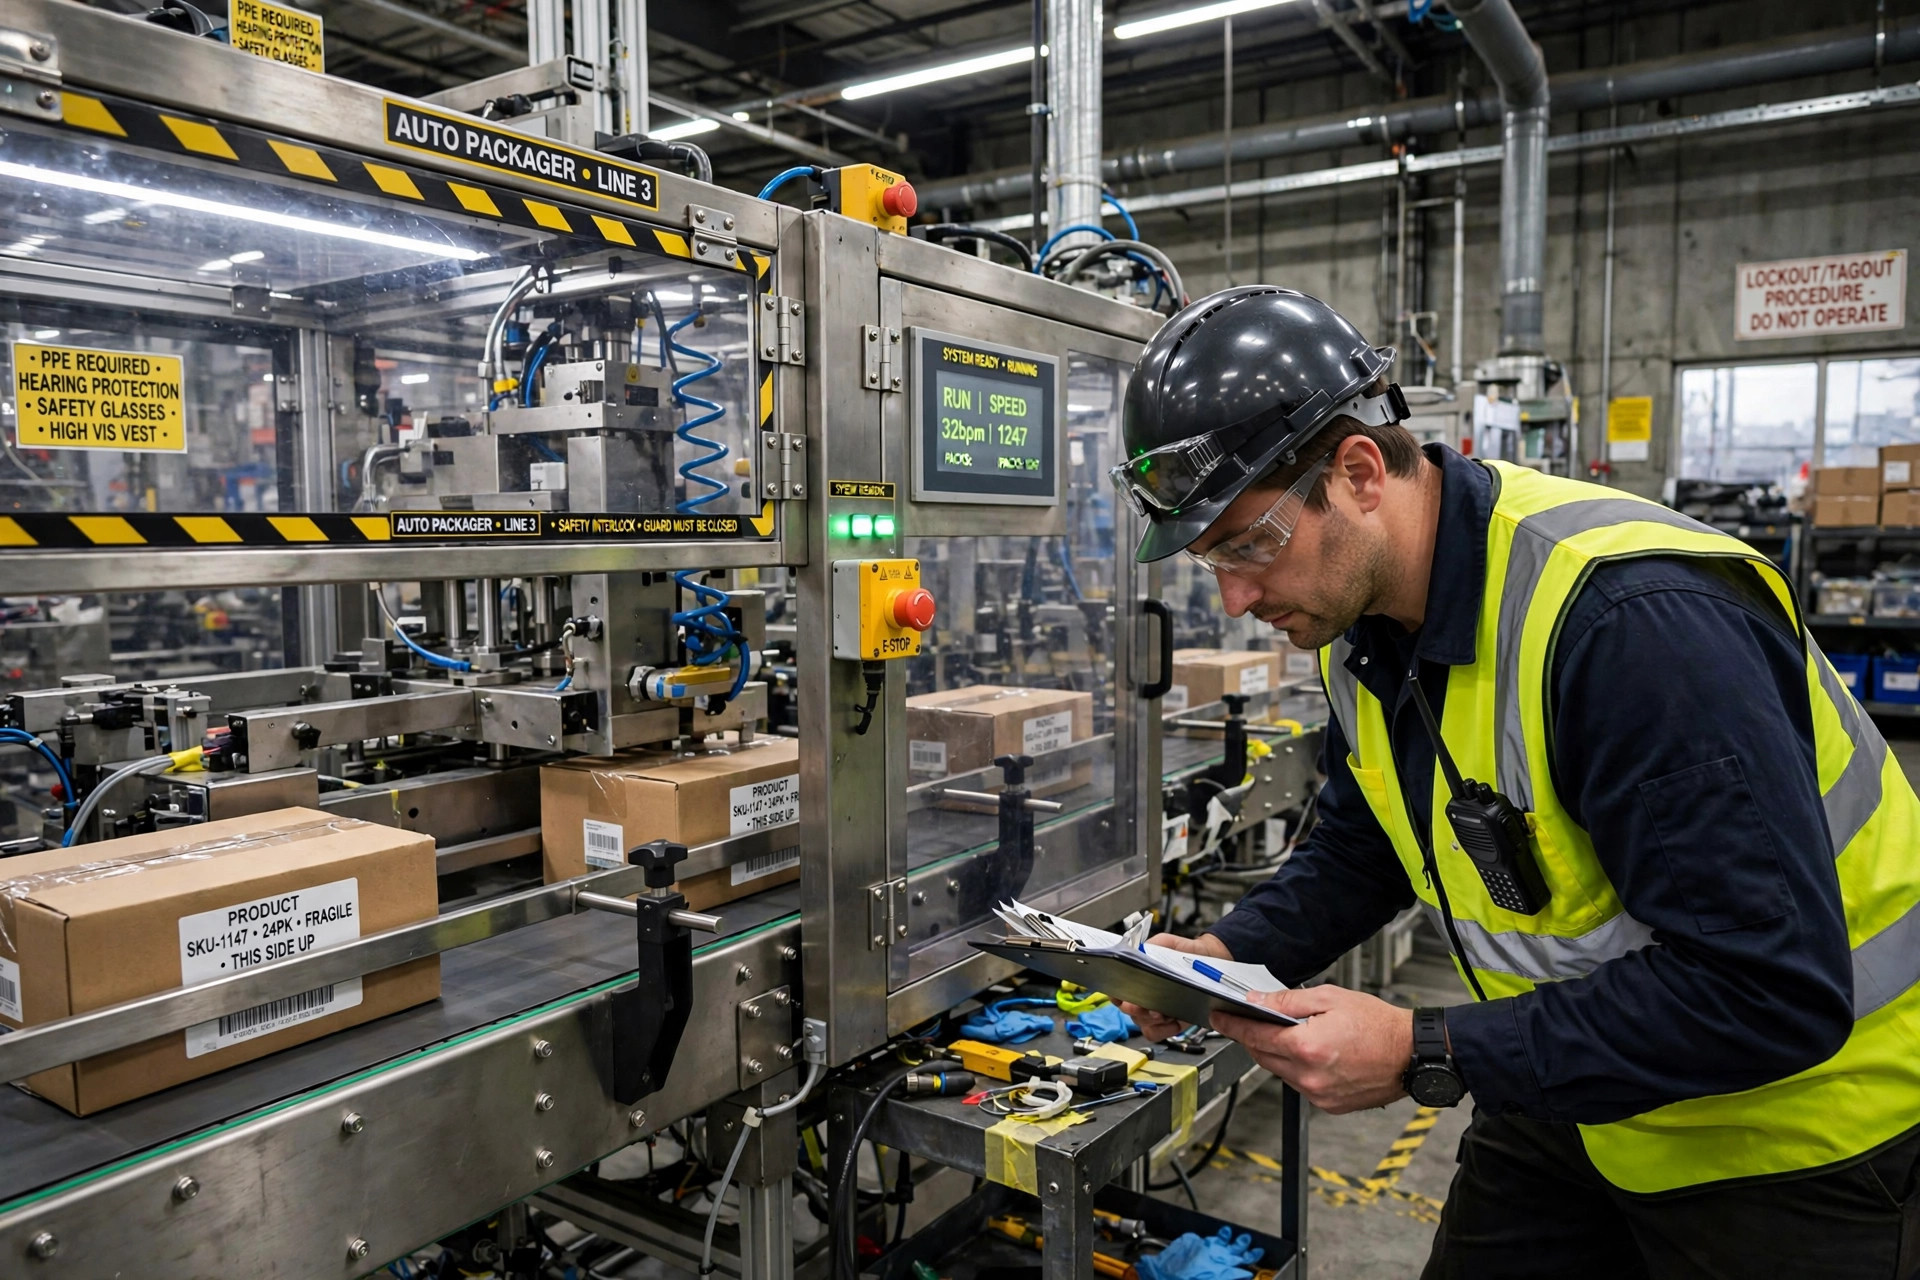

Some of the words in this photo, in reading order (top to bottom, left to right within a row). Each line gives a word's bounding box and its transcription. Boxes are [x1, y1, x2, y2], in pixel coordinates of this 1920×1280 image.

[237, 0, 258, 20] PPE
[262, 8, 314, 36] REQUIRED
[395, 112, 460, 152] AUTO
[466, 130, 577, 182] PACKAGER
[597, 166, 637, 198] LINE
[641, 179, 652, 201] 3
[1746, 258, 1895, 289] LOCKOUT/TAGOUT
[1765, 283, 1864, 308] PROCEDURE
[1751, 313, 1773, 331] DO
[1777, 310, 1809, 329] NOT
[1814, 303, 1888, 327] OPERATE
[41, 350, 71, 370] PPE
[76, 353, 150, 376] REQUIRED
[942, 347, 974, 366] SYSTEM
[19, 372, 87, 394] HEARING
[92, 378, 179, 400] PROTECTION
[37, 397, 96, 417] SAFETY
[100, 401, 166, 421] GLASSES
[943, 387, 971, 411] RUN
[989, 394, 1027, 417] SPEED
[50, 421, 88, 440] HIGH
[92, 423, 116, 441] VIS
[120, 424, 157, 443] VEST
[941, 417, 985, 446] 32bpm
[997, 424, 1028, 447] 1247
[397, 517, 430, 533] AUTO
[432, 517, 493, 533] PACKAGER
[504, 518, 528, 532] LINE
[529, 518, 536, 532] 3
[558, 519, 591, 533] SAFETY
[643, 519, 672, 533] GUARD
[673, 519, 695, 533] MUST
[696, 519, 707, 533] BE
[883, 637, 911, 653] E-STOP
[752, 779, 789, 798] PRODUCT
[228, 895, 300, 927] PRODUCT
[187, 928, 249, 958] SKU-1147
[262, 917, 294, 939] 24PK
[305, 902, 353, 928] FRAGILE
[231, 948, 262, 970] THIS
[265, 938, 295, 961] SIDE
[298, 934, 316, 952] UP
